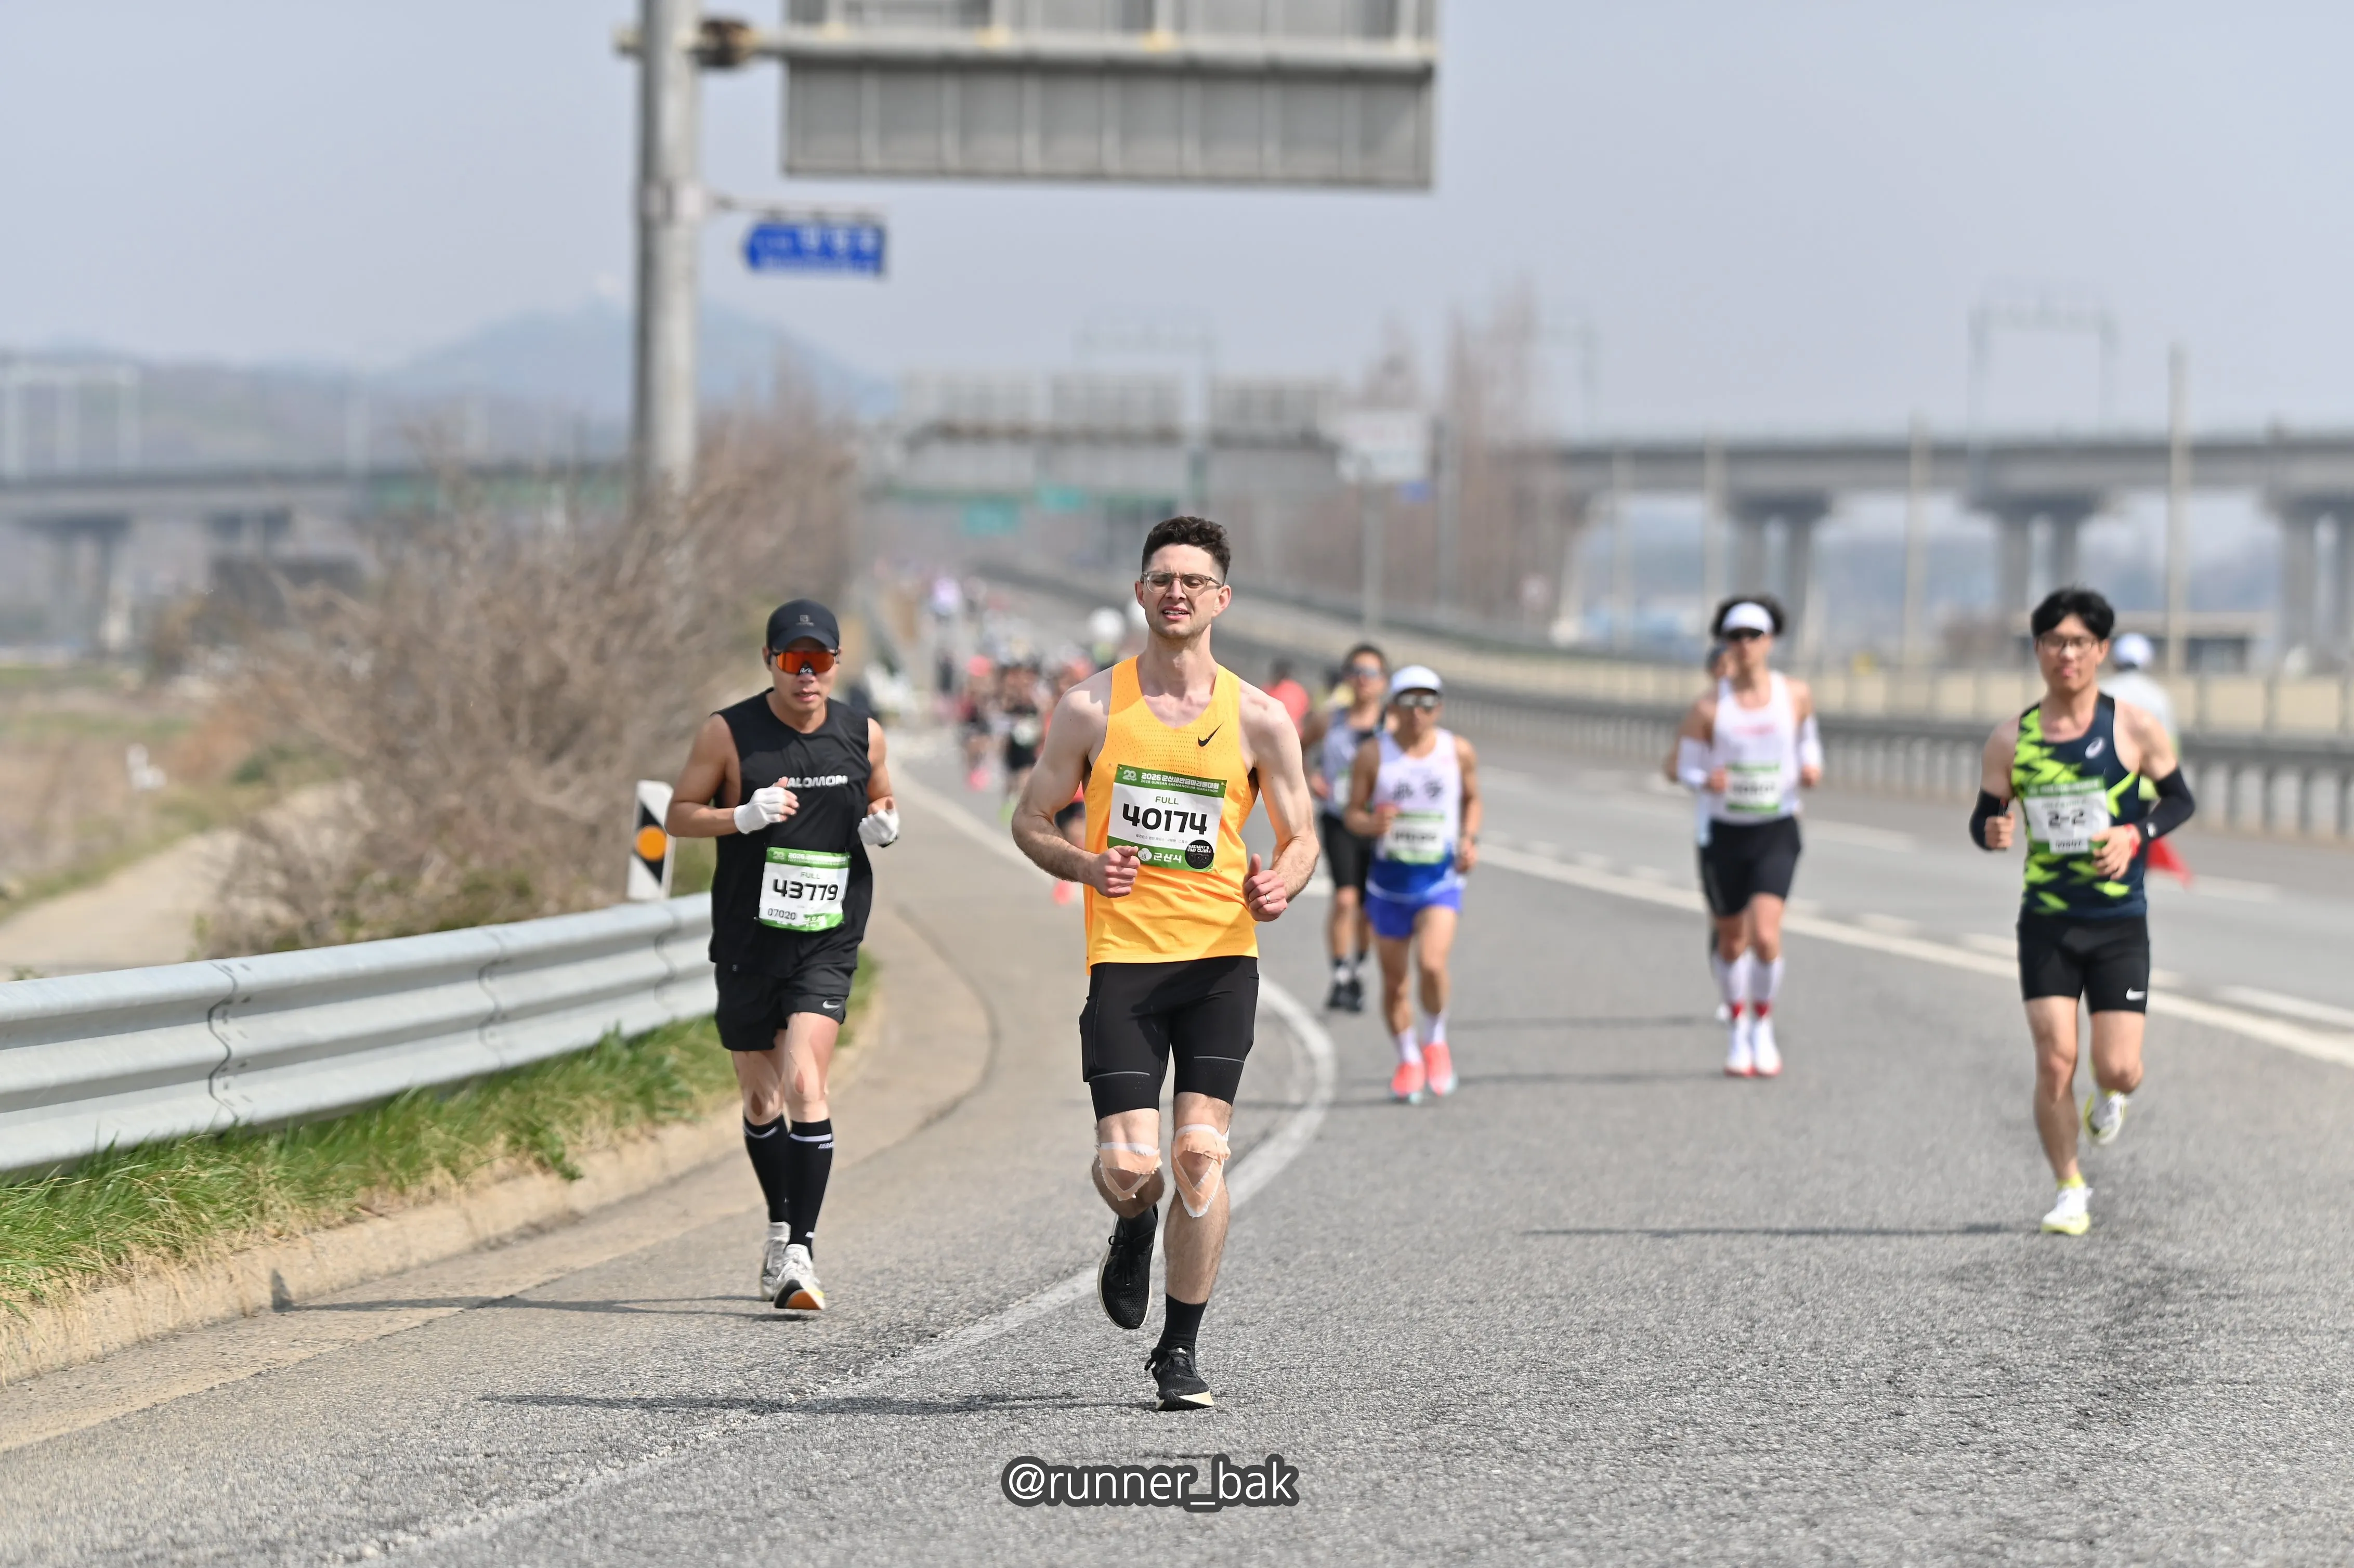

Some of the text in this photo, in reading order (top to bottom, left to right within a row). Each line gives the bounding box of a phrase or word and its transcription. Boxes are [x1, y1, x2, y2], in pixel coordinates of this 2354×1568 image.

[786, 775, 848, 788] ALOMON
[1155, 796, 1179, 805] FULL
[1122, 803, 1207, 835] 40174
[1153, 852, 1182, 864] 군산시
[773, 878, 839, 900] 43779
[767, 908, 796, 920] 07020
